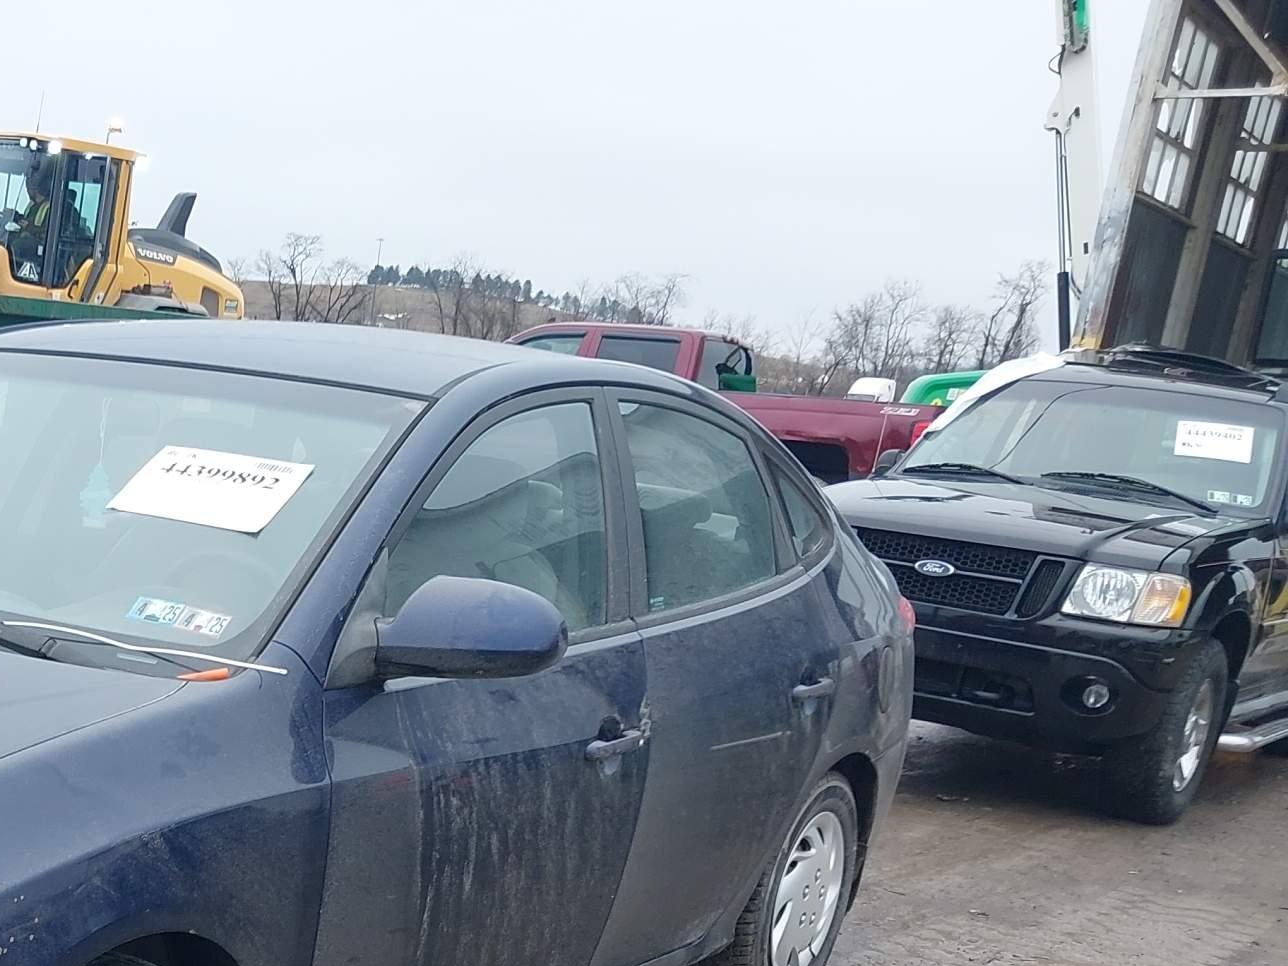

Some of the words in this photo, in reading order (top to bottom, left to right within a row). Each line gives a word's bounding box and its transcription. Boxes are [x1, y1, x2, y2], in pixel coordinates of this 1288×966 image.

[137, 248, 174, 263] VOLVO
[160, 461, 281, 490] 44399892
[922, 562, 945, 573] Ford
[136, 603, 148, 617] 4
[183, 613, 196, 628] 4
